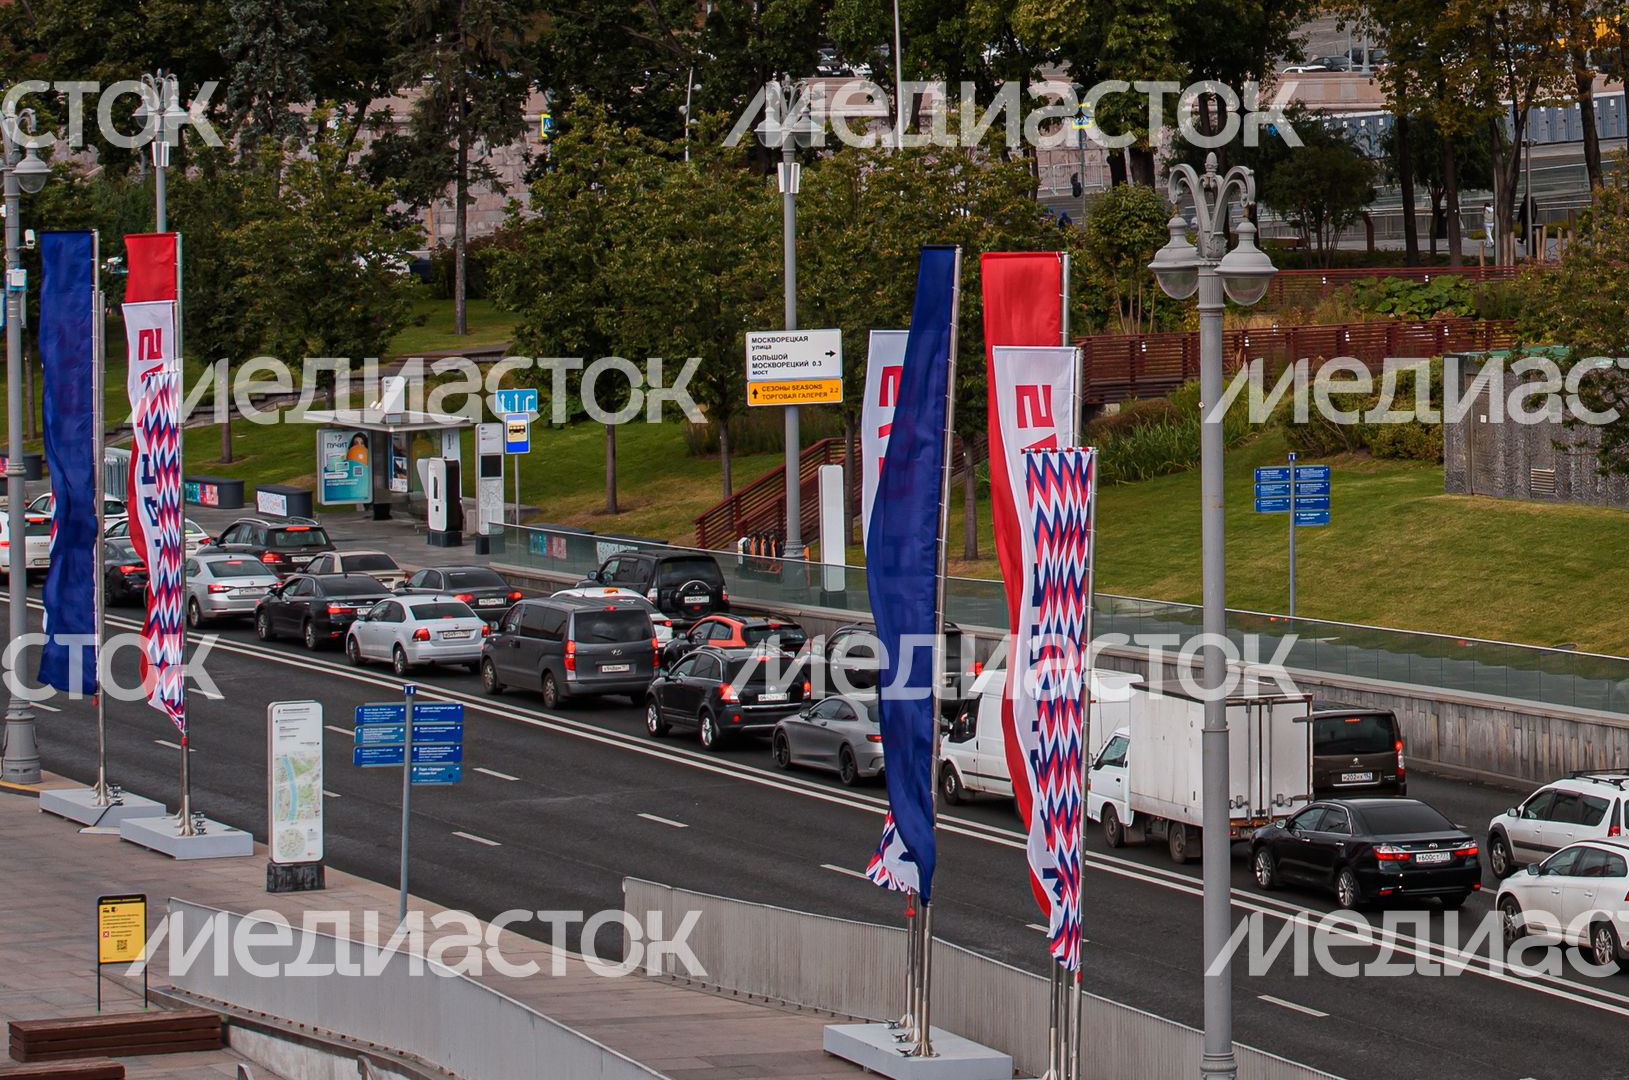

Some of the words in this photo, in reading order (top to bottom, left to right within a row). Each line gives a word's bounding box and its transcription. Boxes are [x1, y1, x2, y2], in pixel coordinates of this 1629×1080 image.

[751, 335, 809, 344] МОСКВОРЕЦКАЯ
[751, 352, 788, 361] БОЛЬШОЙ
[752, 360, 809, 369] МОСКВОРЕЦКИЙ
